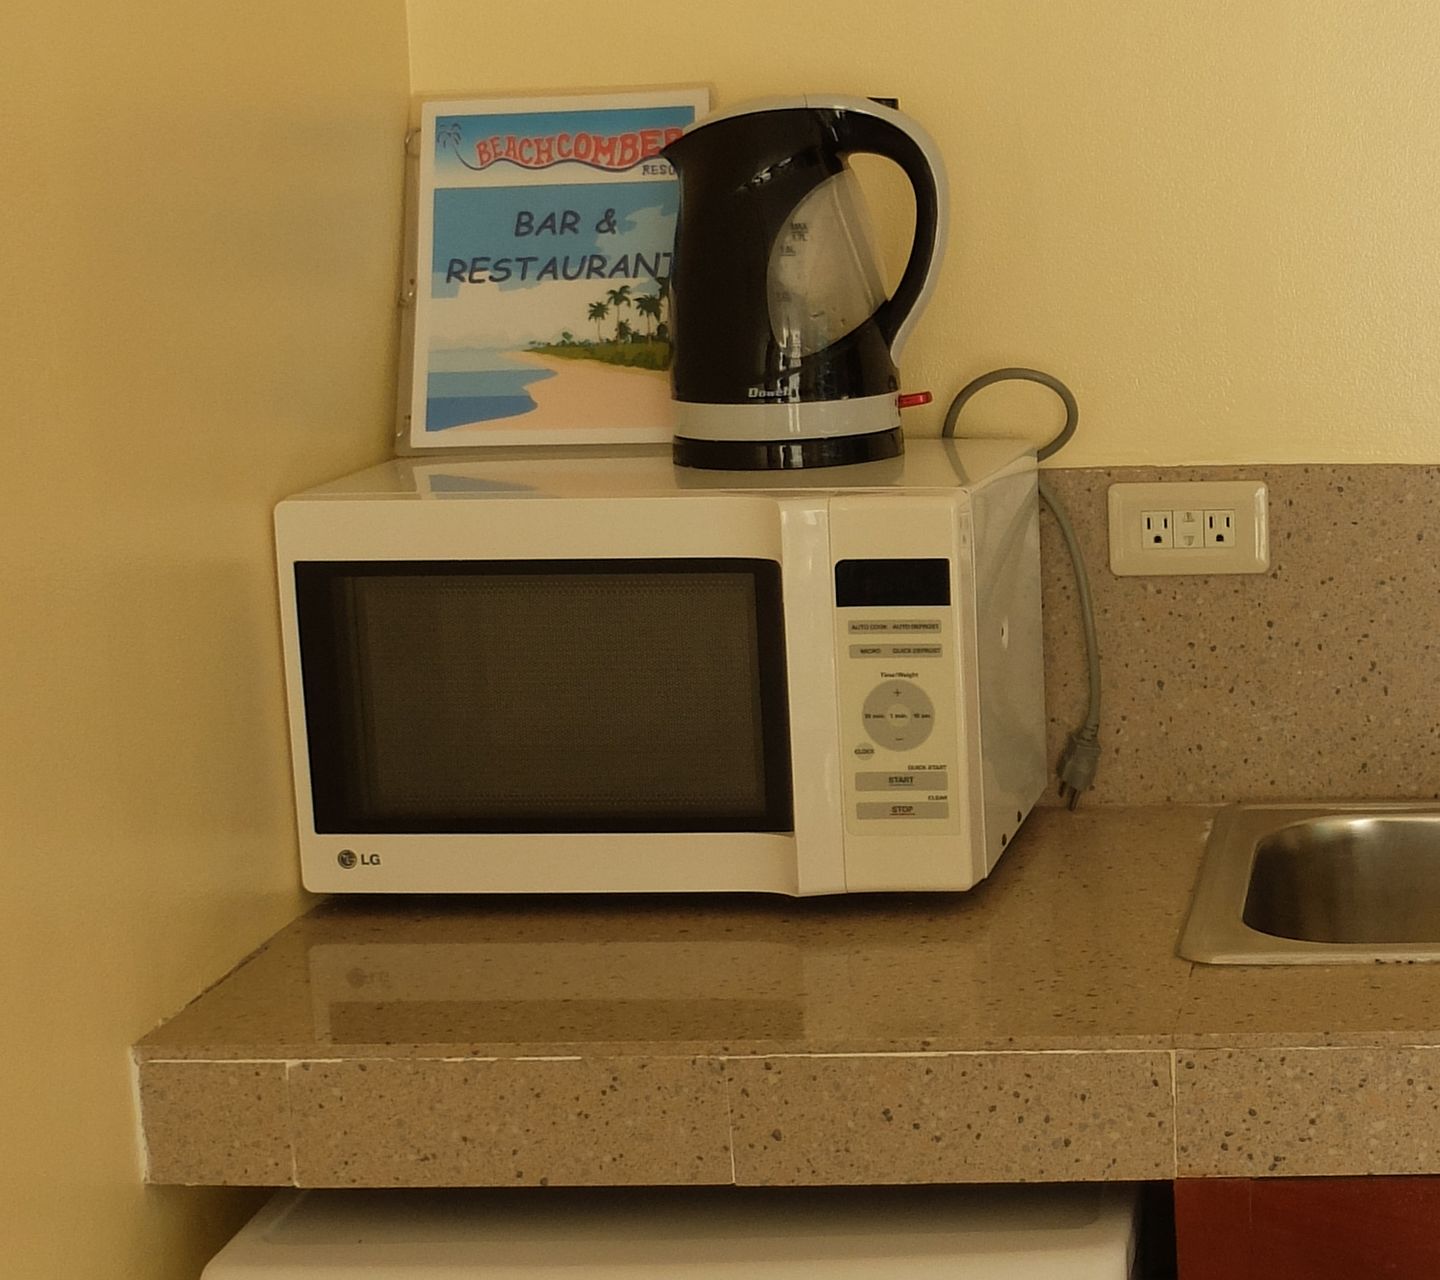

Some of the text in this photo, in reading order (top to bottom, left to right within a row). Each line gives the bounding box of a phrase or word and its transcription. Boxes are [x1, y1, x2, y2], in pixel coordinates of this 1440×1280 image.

[641, 164, 676, 176] RESO
[514, 208, 617, 237] BAR &
[446, 252, 674, 284] RESTAURANT
[888, 776, 914, 784] START
[891, 805, 914, 813] STOP
[361, 853, 381, 866] LG
